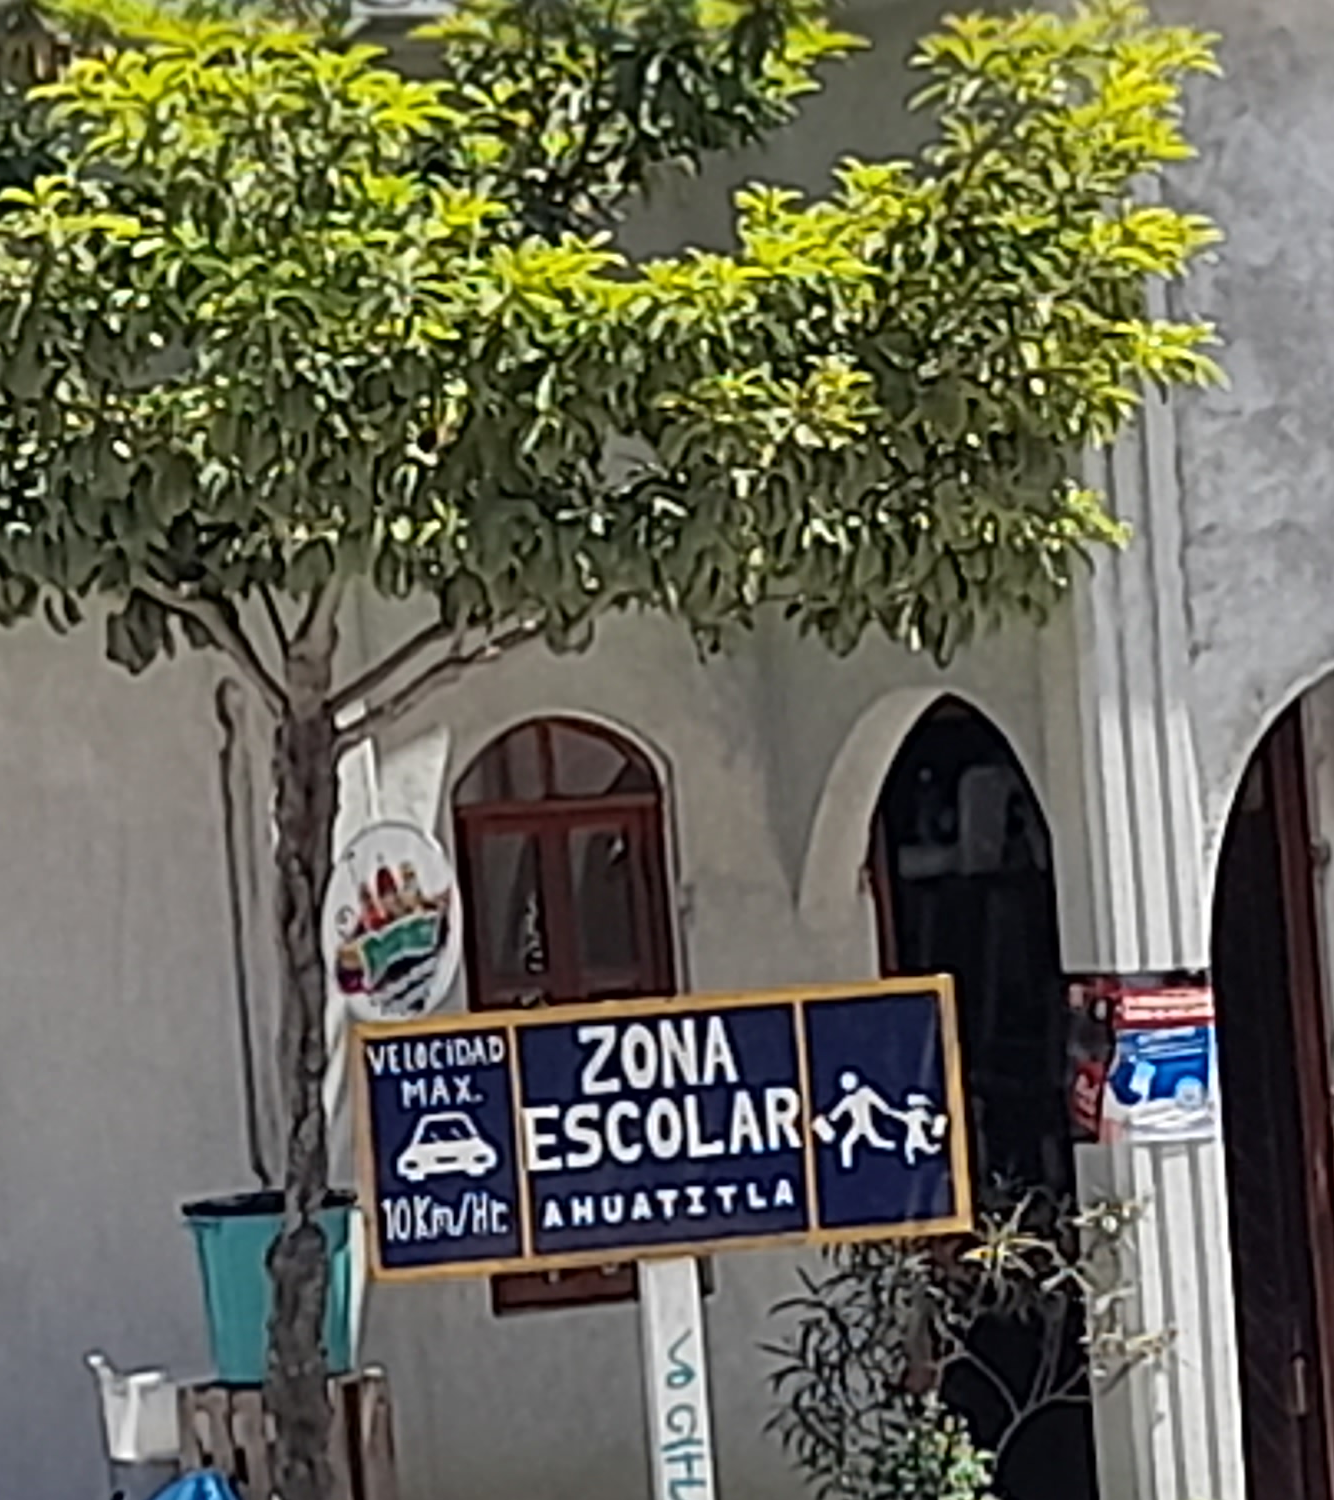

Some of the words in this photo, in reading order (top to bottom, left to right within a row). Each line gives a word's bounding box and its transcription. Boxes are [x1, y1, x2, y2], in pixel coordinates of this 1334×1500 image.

[578, 1015, 738, 1095] ZONA
[523, 1087, 802, 1171] ESCOLAR
[544, 1179, 794, 1227] AHUATITLA
